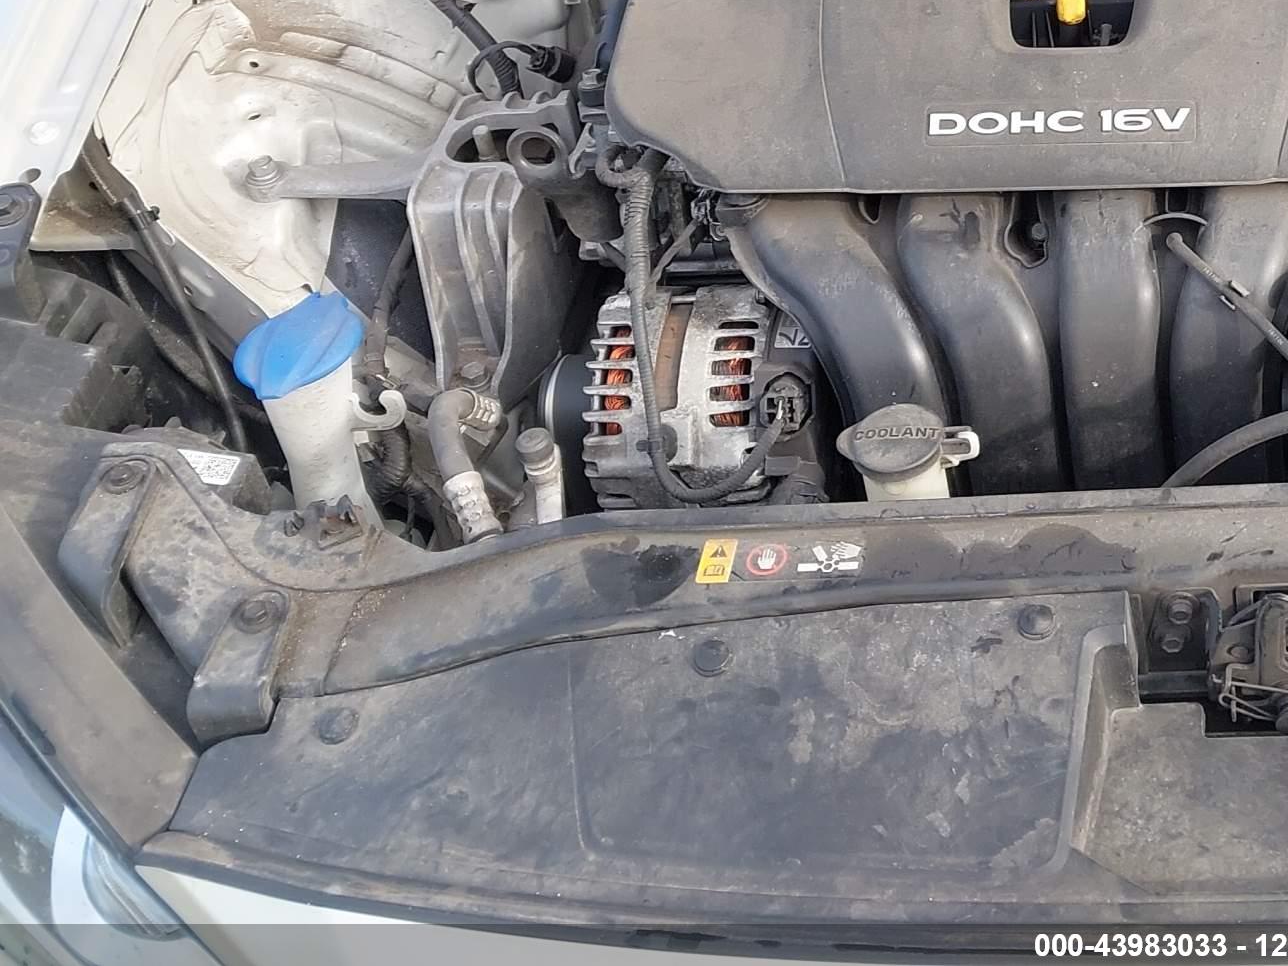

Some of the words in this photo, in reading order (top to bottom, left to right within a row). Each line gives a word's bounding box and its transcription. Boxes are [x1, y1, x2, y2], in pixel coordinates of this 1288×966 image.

[927, 110, 1085, 136] DOHC
[1098, 107, 1192, 133] 16V
[854, 427, 941, 442] COOLANT
